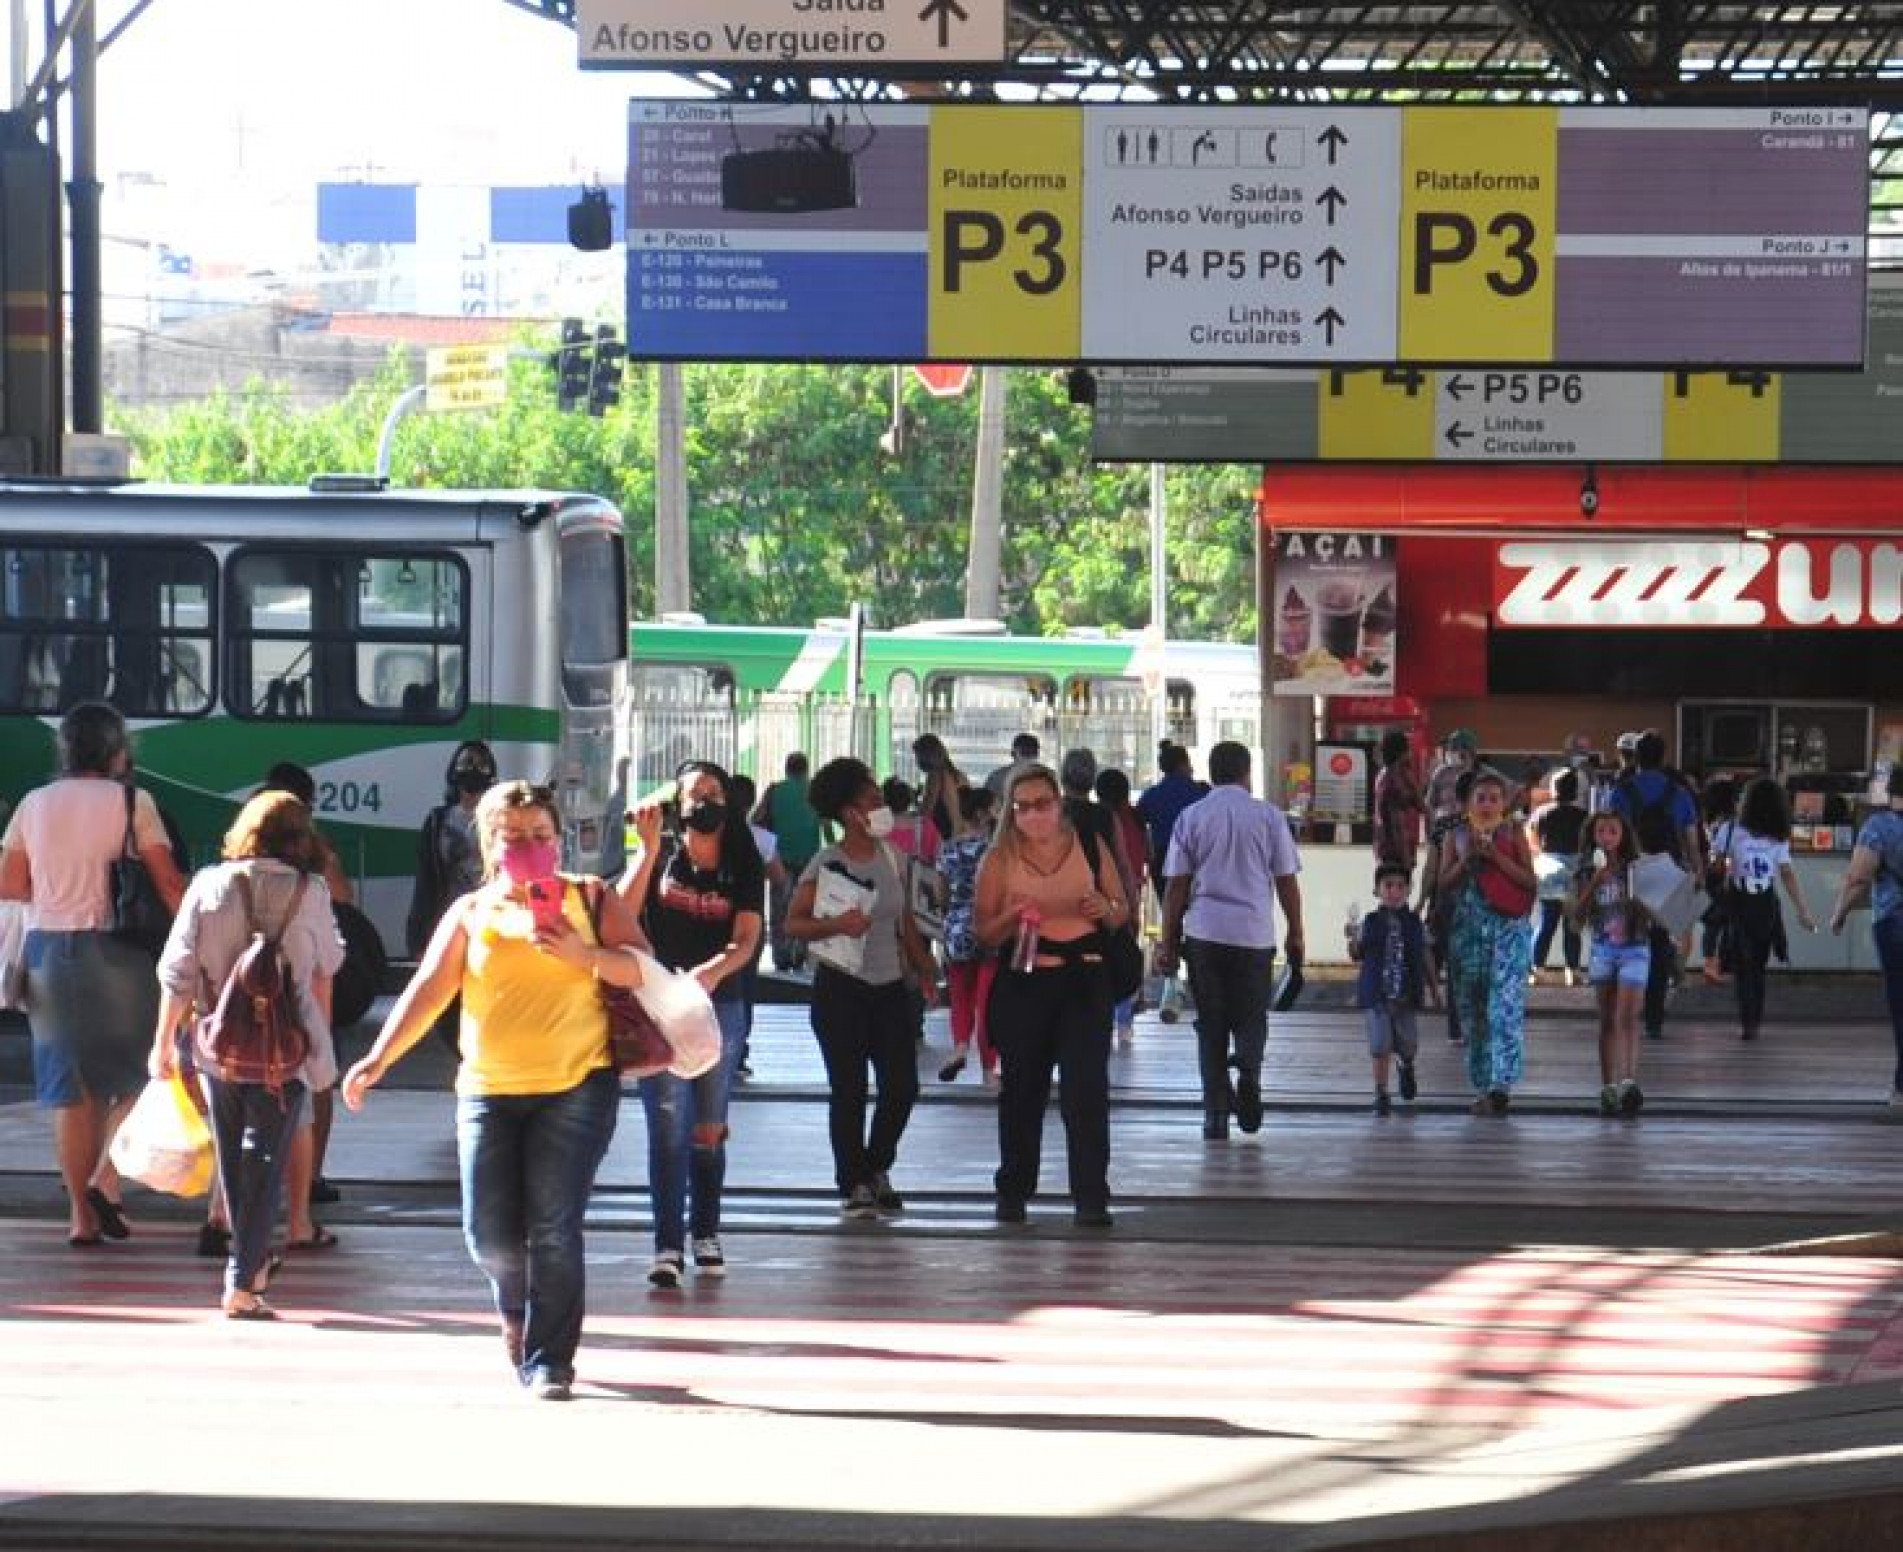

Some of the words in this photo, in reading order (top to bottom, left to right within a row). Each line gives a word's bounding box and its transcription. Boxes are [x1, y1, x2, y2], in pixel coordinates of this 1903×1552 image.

[593, 23, 712, 52] Afonso
[723, 23, 886, 60] Vergueiro
[1771, 111, 1823, 126] Ponto
[943, 168, 1067, 190] Plataforma
[1415, 170, 1540, 192] Plataforma
[1111, 205, 1191, 225] Afonso
[1198, 205, 1303, 229] Vergueiro
[664, 231, 714, 247] Ponto
[1762, 238, 1815, 253] Ponto
[1819, 239, 1829, 253] J
[943, 210, 1066, 295] P3
[1413, 211, 1539, 296] P3
[1145, 248, 1189, 280] P4
[1202, 248, 1246, 280] P5
[1258, 248, 1303, 280] P6
[1228, 306, 1302, 325] Linhas
[1190, 326, 1302, 345] Circulares
[1483, 374, 1529, 404] P5
[1538, 374, 1583, 404] P6
[1483, 415, 1545, 433] Linhas
[1483, 436, 1577, 455] Circulares
